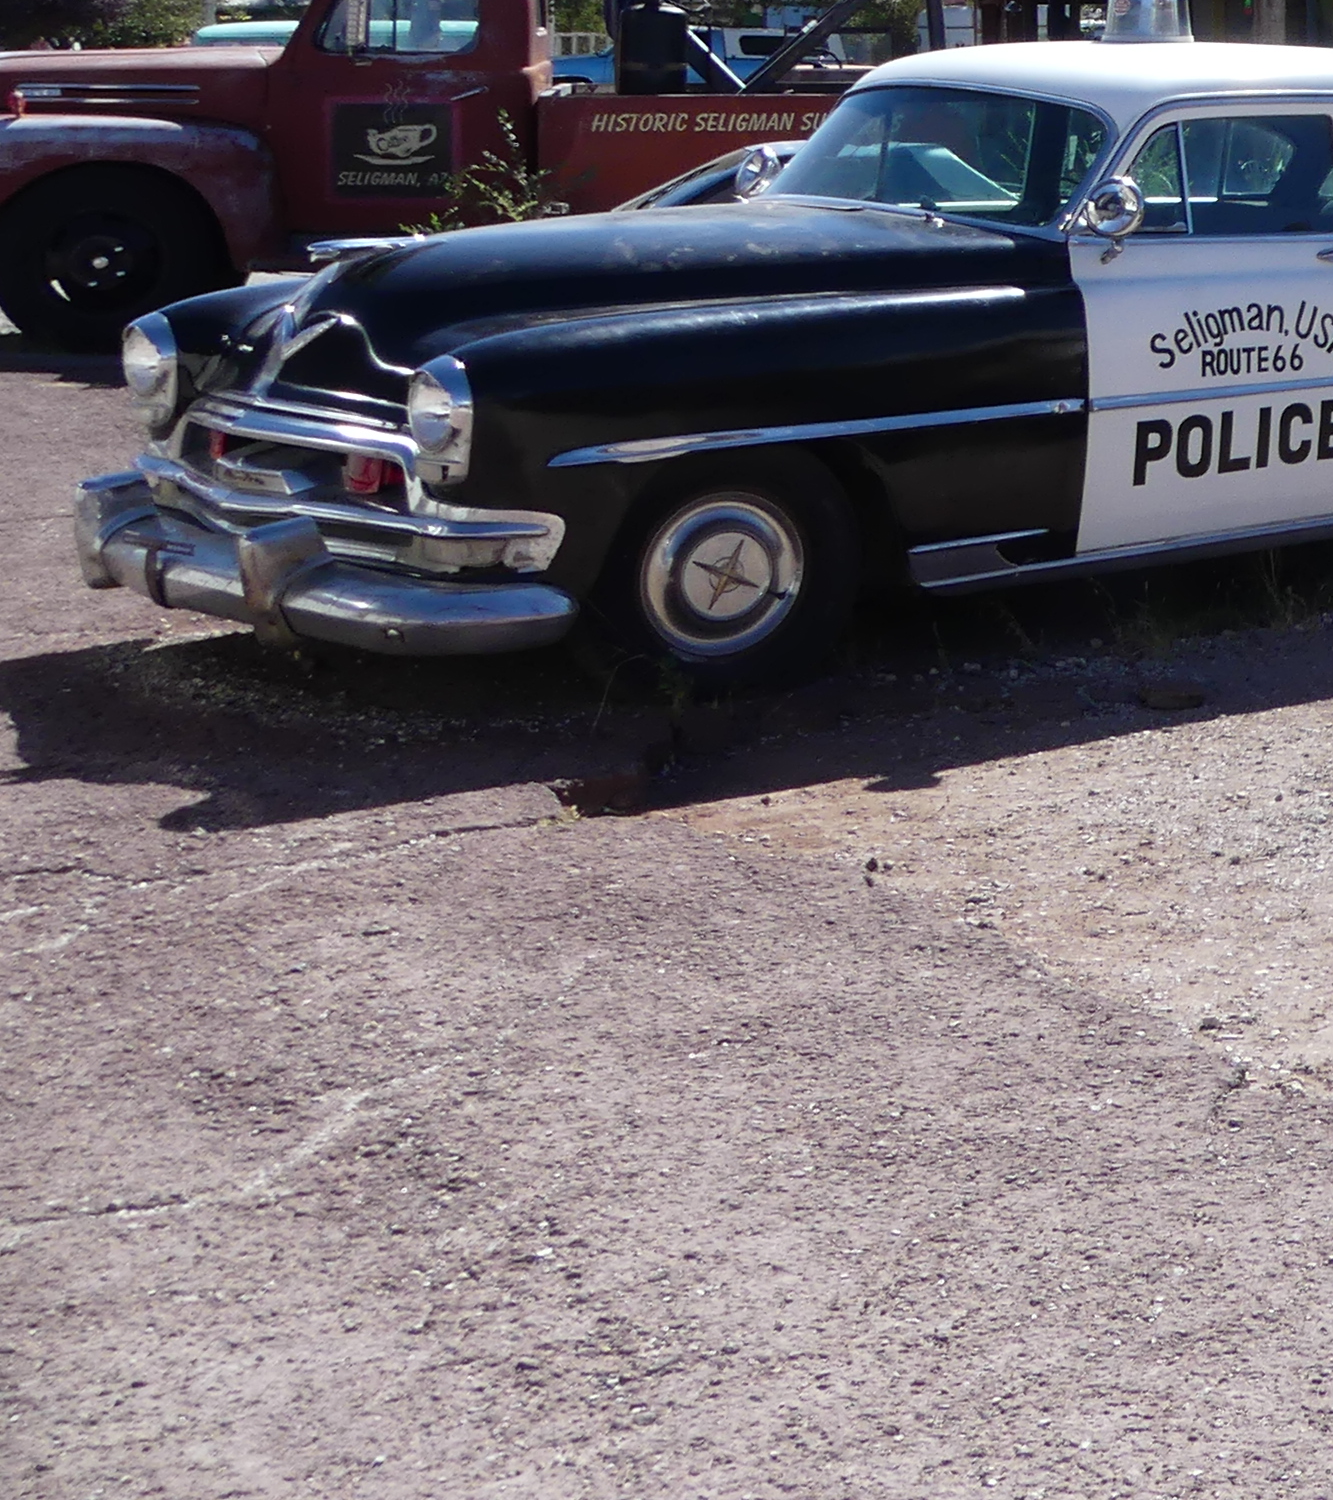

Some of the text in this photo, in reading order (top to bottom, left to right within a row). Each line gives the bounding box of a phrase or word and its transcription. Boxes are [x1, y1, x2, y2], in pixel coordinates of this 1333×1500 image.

[591, 112, 689, 133] HISTORIC
[694, 112, 795, 133] SELIGMAN
[337, 171, 421, 187] SELIGMAN,
[1150, 302, 1290, 369] Seligman,
[1201, 343, 1304, 378] ROUTE 66
